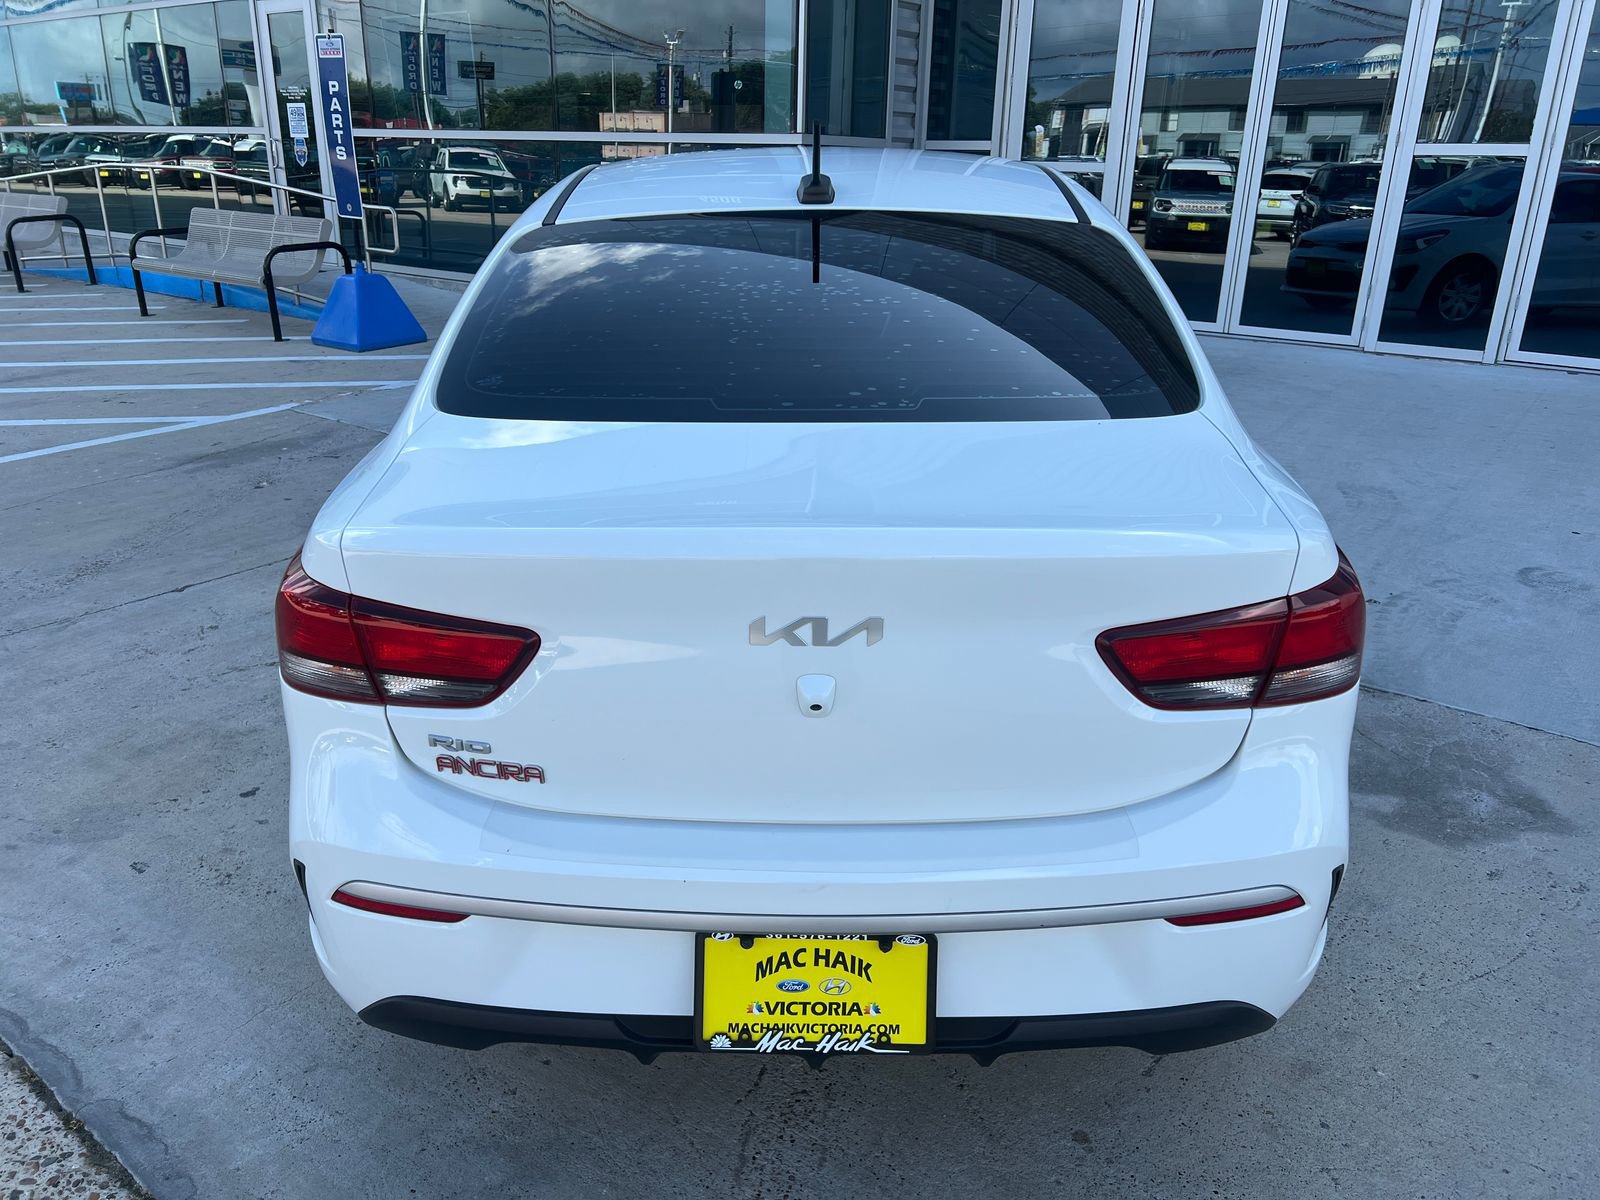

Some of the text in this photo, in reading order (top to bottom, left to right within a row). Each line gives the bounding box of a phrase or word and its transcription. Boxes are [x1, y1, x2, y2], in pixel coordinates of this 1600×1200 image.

[328, 81, 347, 160] PARTS
[749, 616, 884, 647] KIA
[428, 734, 491, 754] RIO
[436, 754, 545, 784] ANCIRA
[755, 948, 872, 983] MAC HAIK
[765, 1001, 863, 1016] VICTORIA
[755, 1030, 882, 1053] Mac Haik
